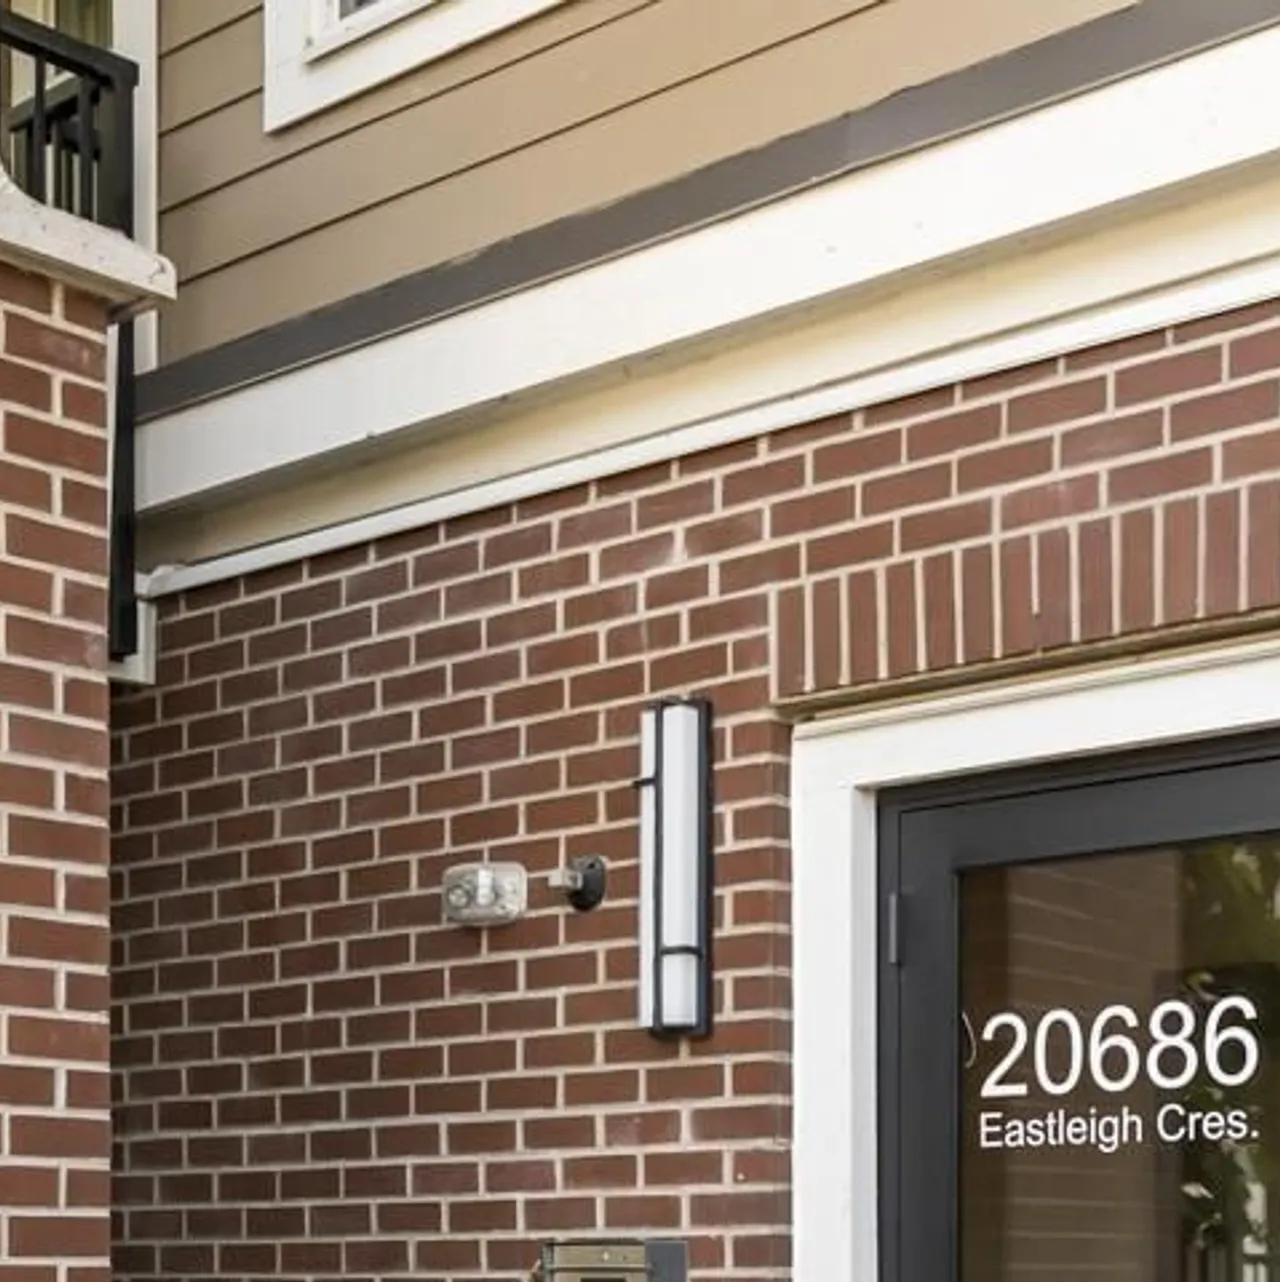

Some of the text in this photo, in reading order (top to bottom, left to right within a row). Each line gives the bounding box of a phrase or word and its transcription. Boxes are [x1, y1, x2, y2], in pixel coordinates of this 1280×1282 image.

[981, 996, 1260, 1098] 20686
[980, 1104, 1260, 1154] Eastleigh Cres.
